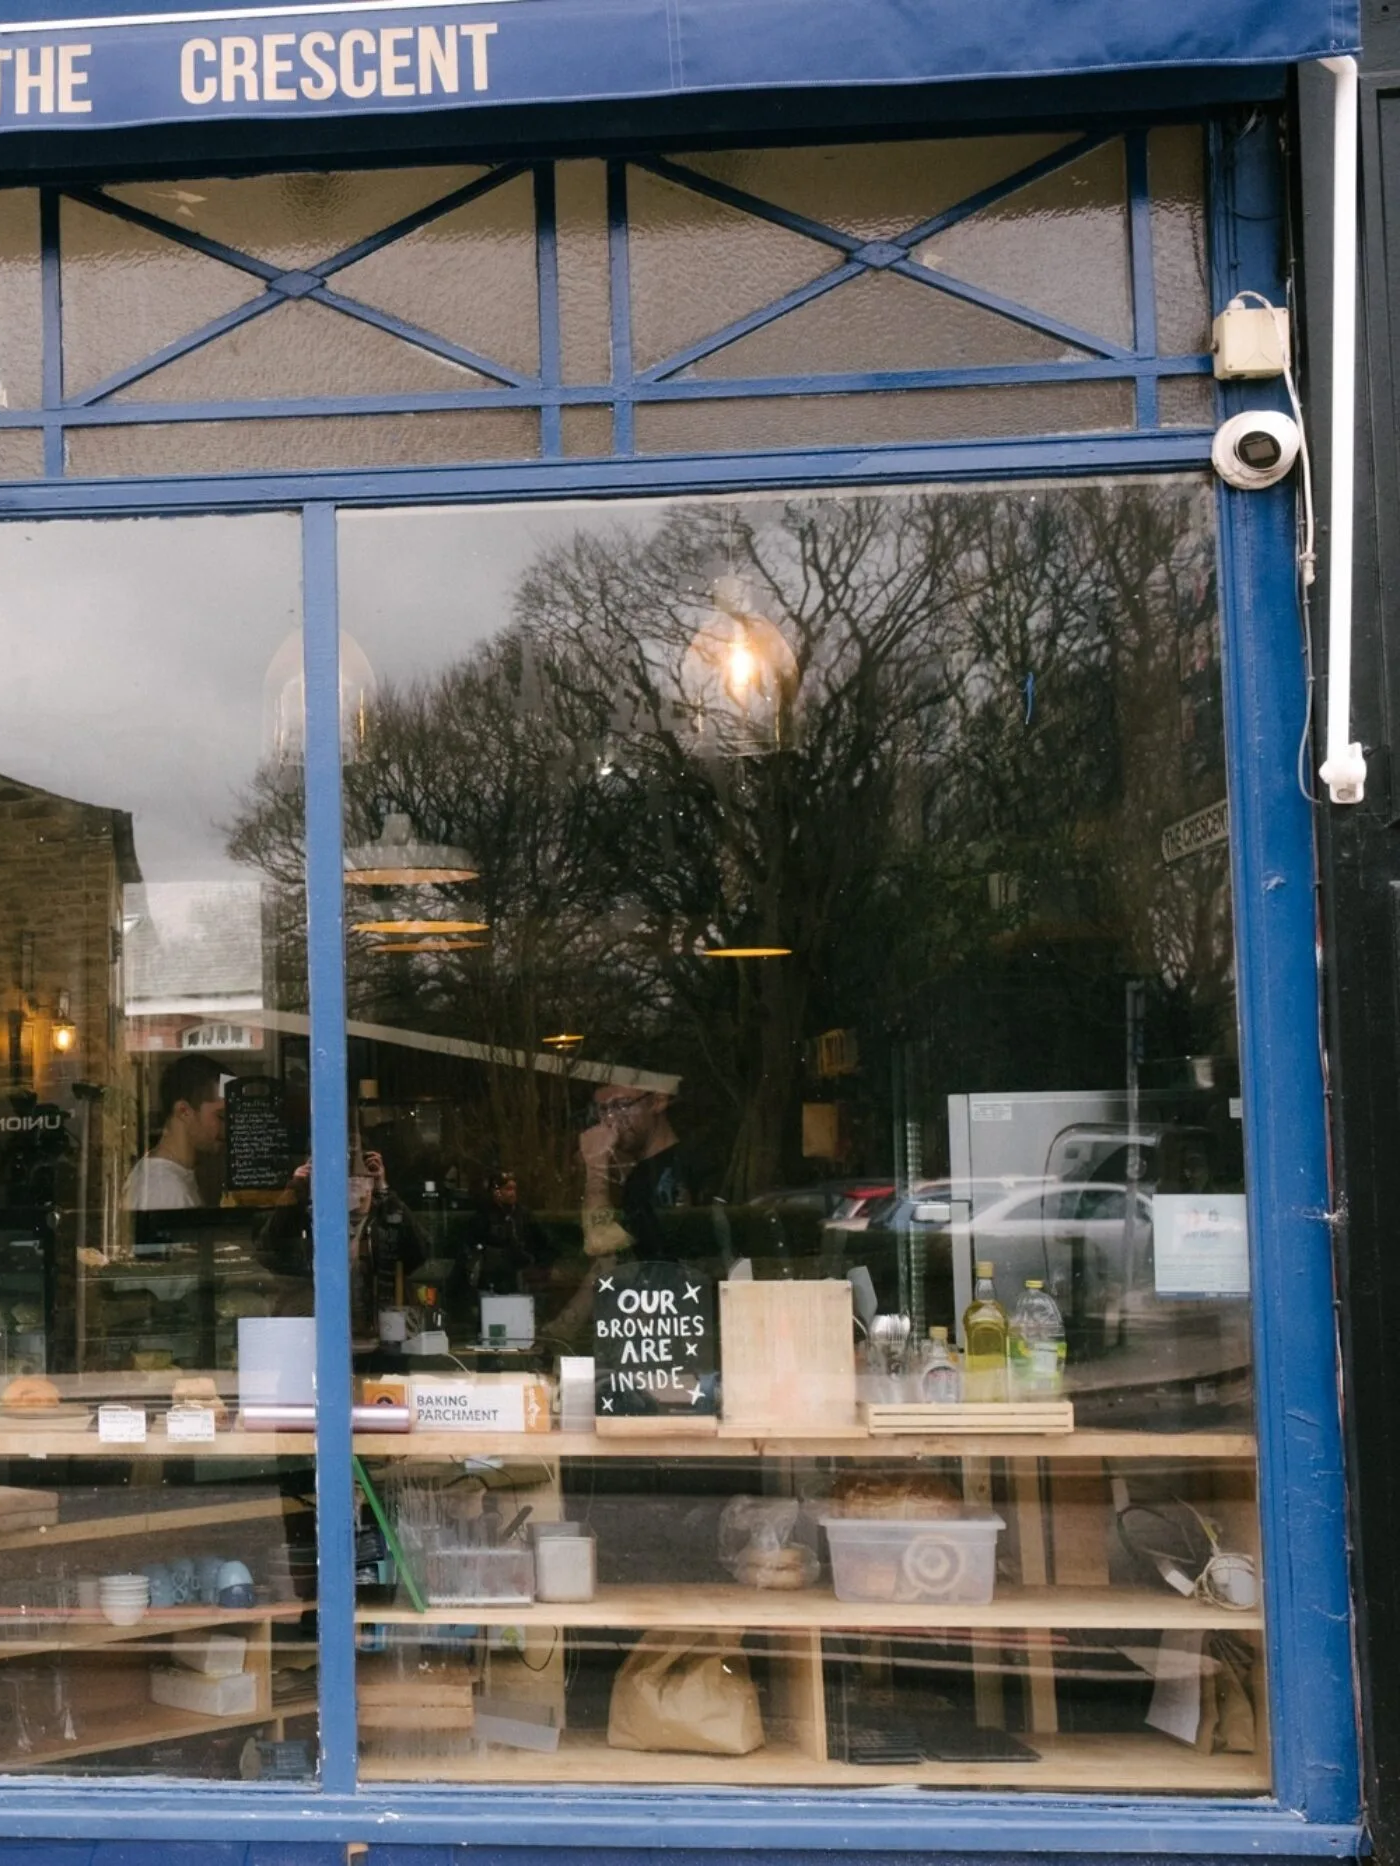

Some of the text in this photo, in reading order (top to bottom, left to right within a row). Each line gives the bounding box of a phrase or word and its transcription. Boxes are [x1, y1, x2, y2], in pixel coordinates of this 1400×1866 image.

[179, 22, 498, 105] CRESCENT
[617, 1289, 678, 1315] OUR
[597, 1315, 704, 1338] BROWNIES
[620, 1339, 672, 1364] ARE
[610, 1366, 684, 1392] INSIDE
[416, 1395, 468, 1407] BAKING
[417, 1408, 498, 1421] PARCHMENT
